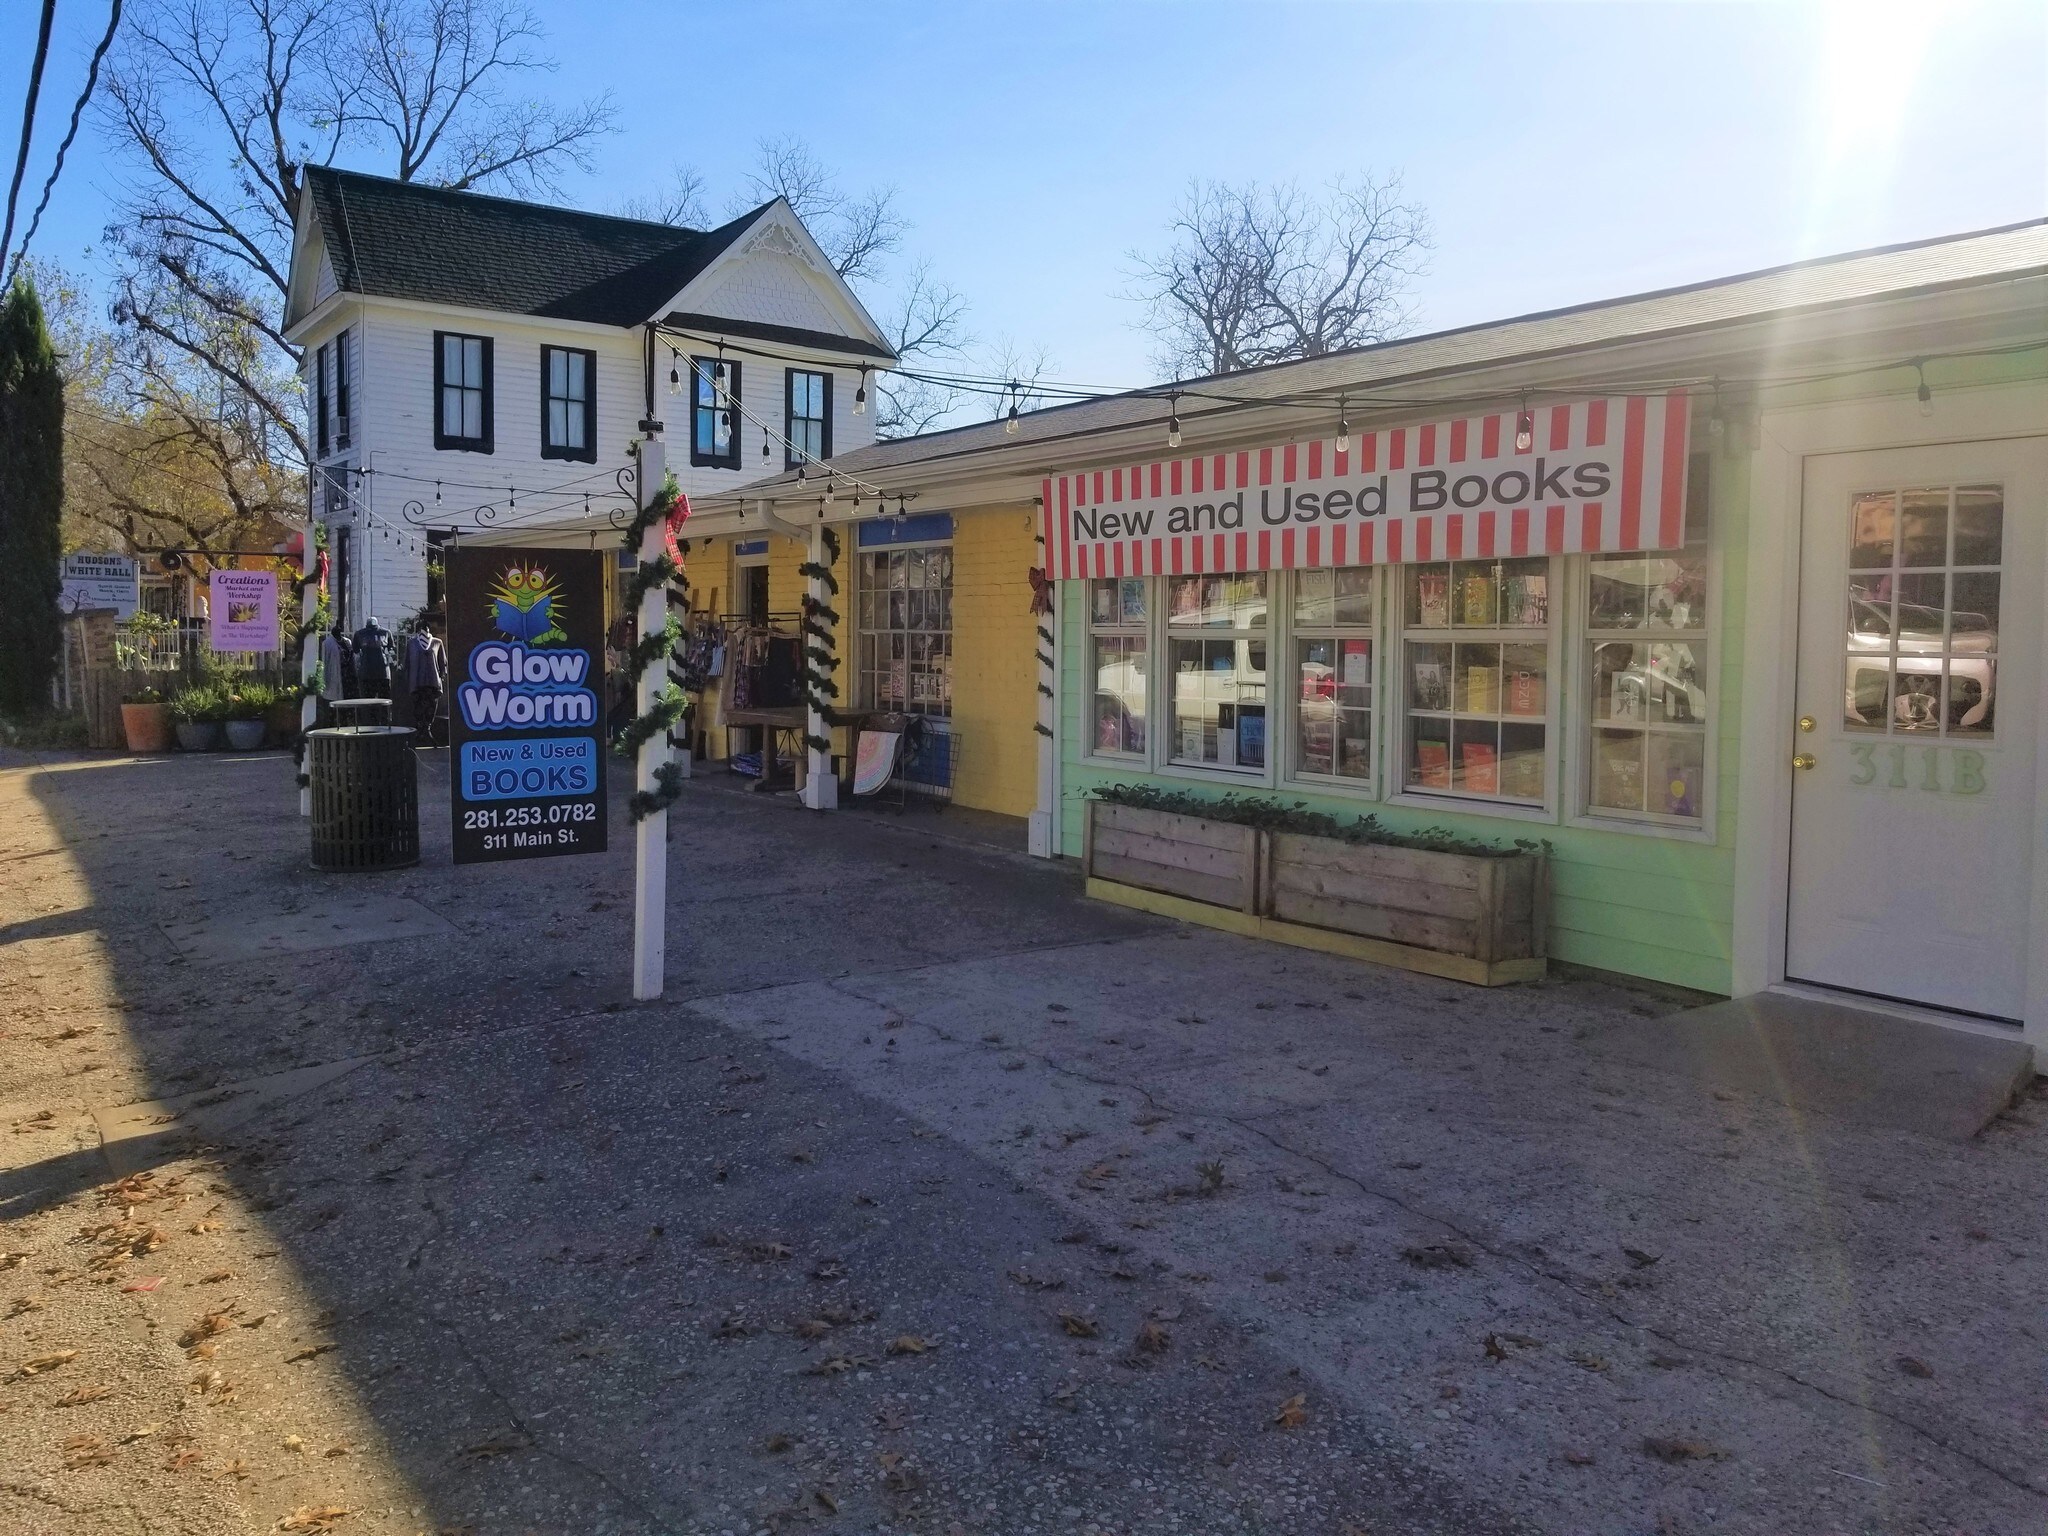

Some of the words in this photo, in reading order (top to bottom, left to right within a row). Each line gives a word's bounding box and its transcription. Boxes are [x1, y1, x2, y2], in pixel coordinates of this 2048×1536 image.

[1073, 507, 1154, 541] New
[1167, 492, 1244, 533] and
[1261, 475, 1388, 525] Used
[1410, 457, 1611, 512] Books
[68, 566, 102, 576] WHITE
[104, 567, 131, 577] HALL
[77, 556, 122, 566] HUDSONS
[218, 574, 270, 585] Creations
[226, 591, 262, 601] Workshop
[475, 647, 584, 684] Glow
[464, 687, 592, 724] Worm
[472, 745, 514, 763] New
[520, 744, 534, 760] &
[540, 742, 587, 759] Used
[471, 765, 589, 795] BOOKS
[1850, 742, 1987, 795] 311B
[464, 803, 596, 829] 281.253.0782
[484, 834, 507, 849] 311
[513, 831, 552, 847] Main
[558, 829, 579, 843] St.
